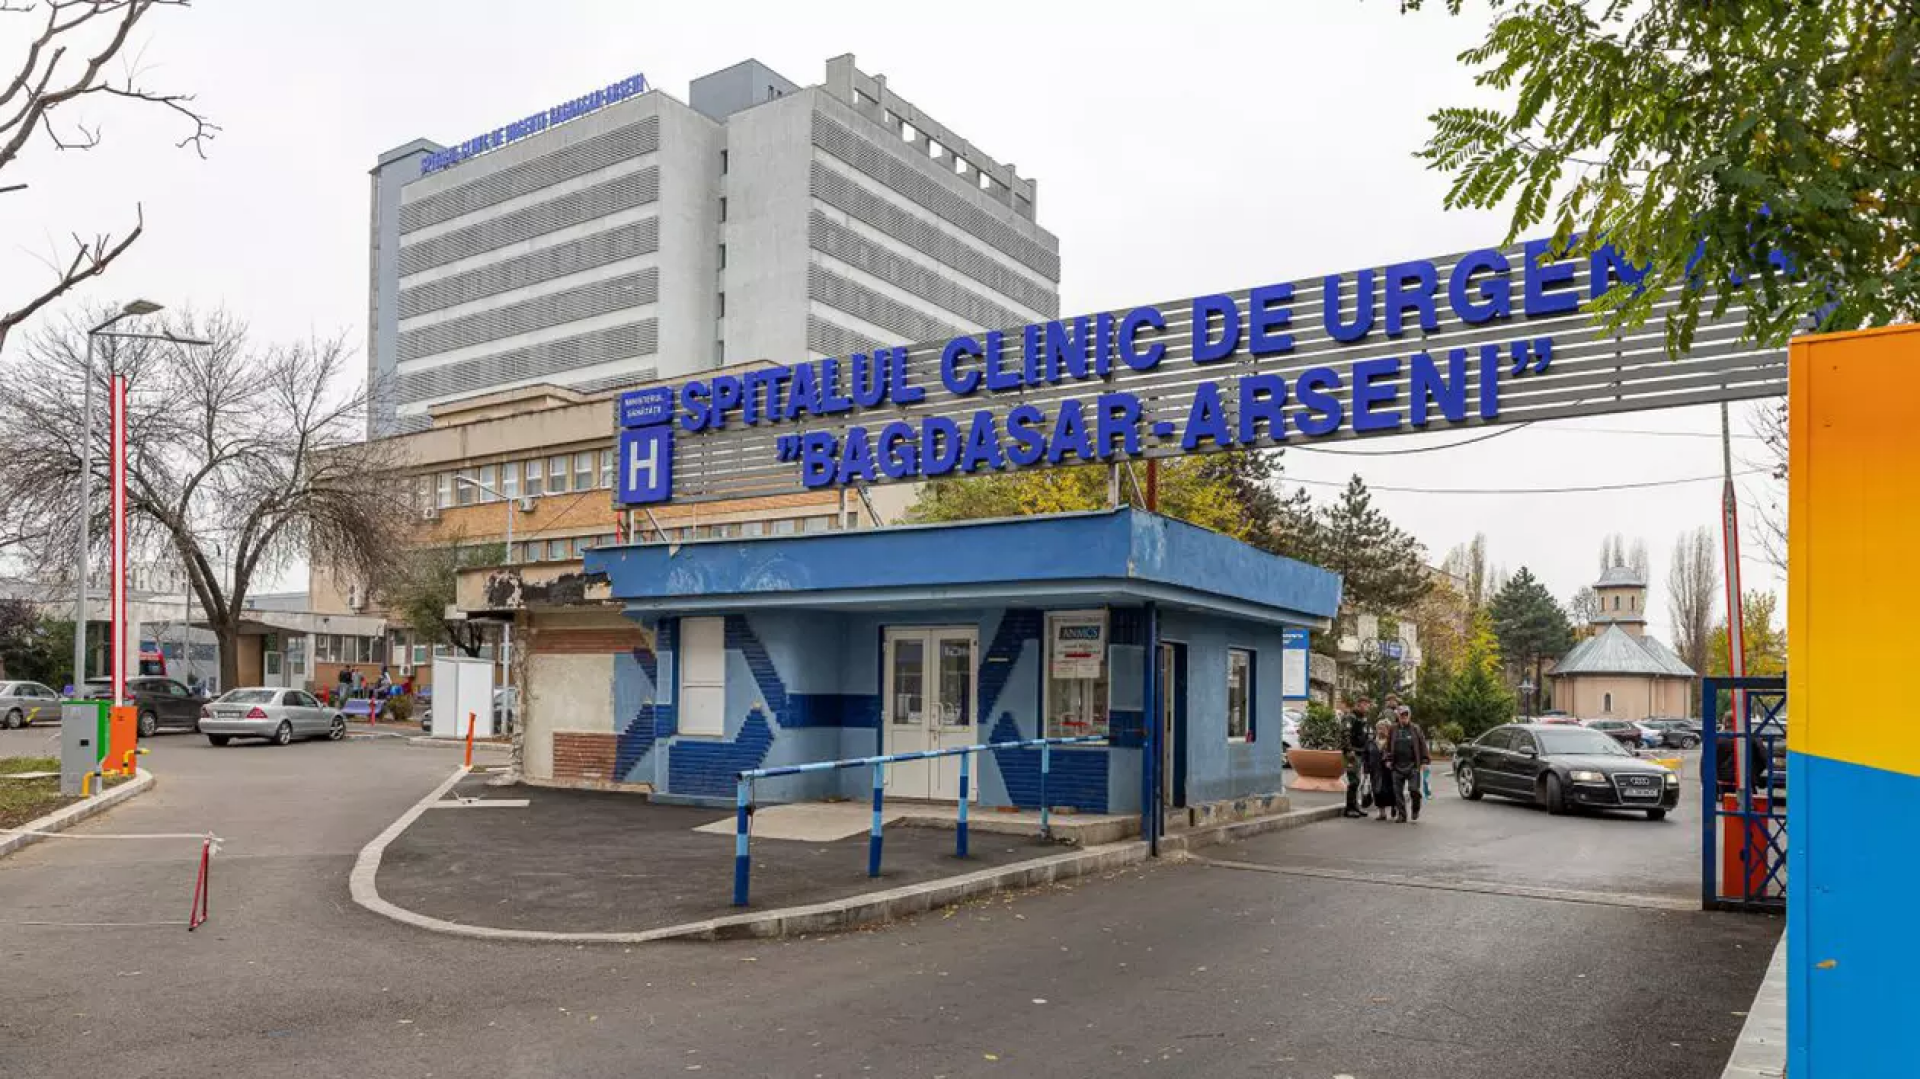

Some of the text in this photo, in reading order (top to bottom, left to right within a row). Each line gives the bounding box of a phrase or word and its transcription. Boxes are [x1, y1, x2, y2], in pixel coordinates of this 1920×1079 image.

[681, 202, 1798, 431] SPITALUL CLINIC DE URGEN
[628, 438, 658, 492] H
